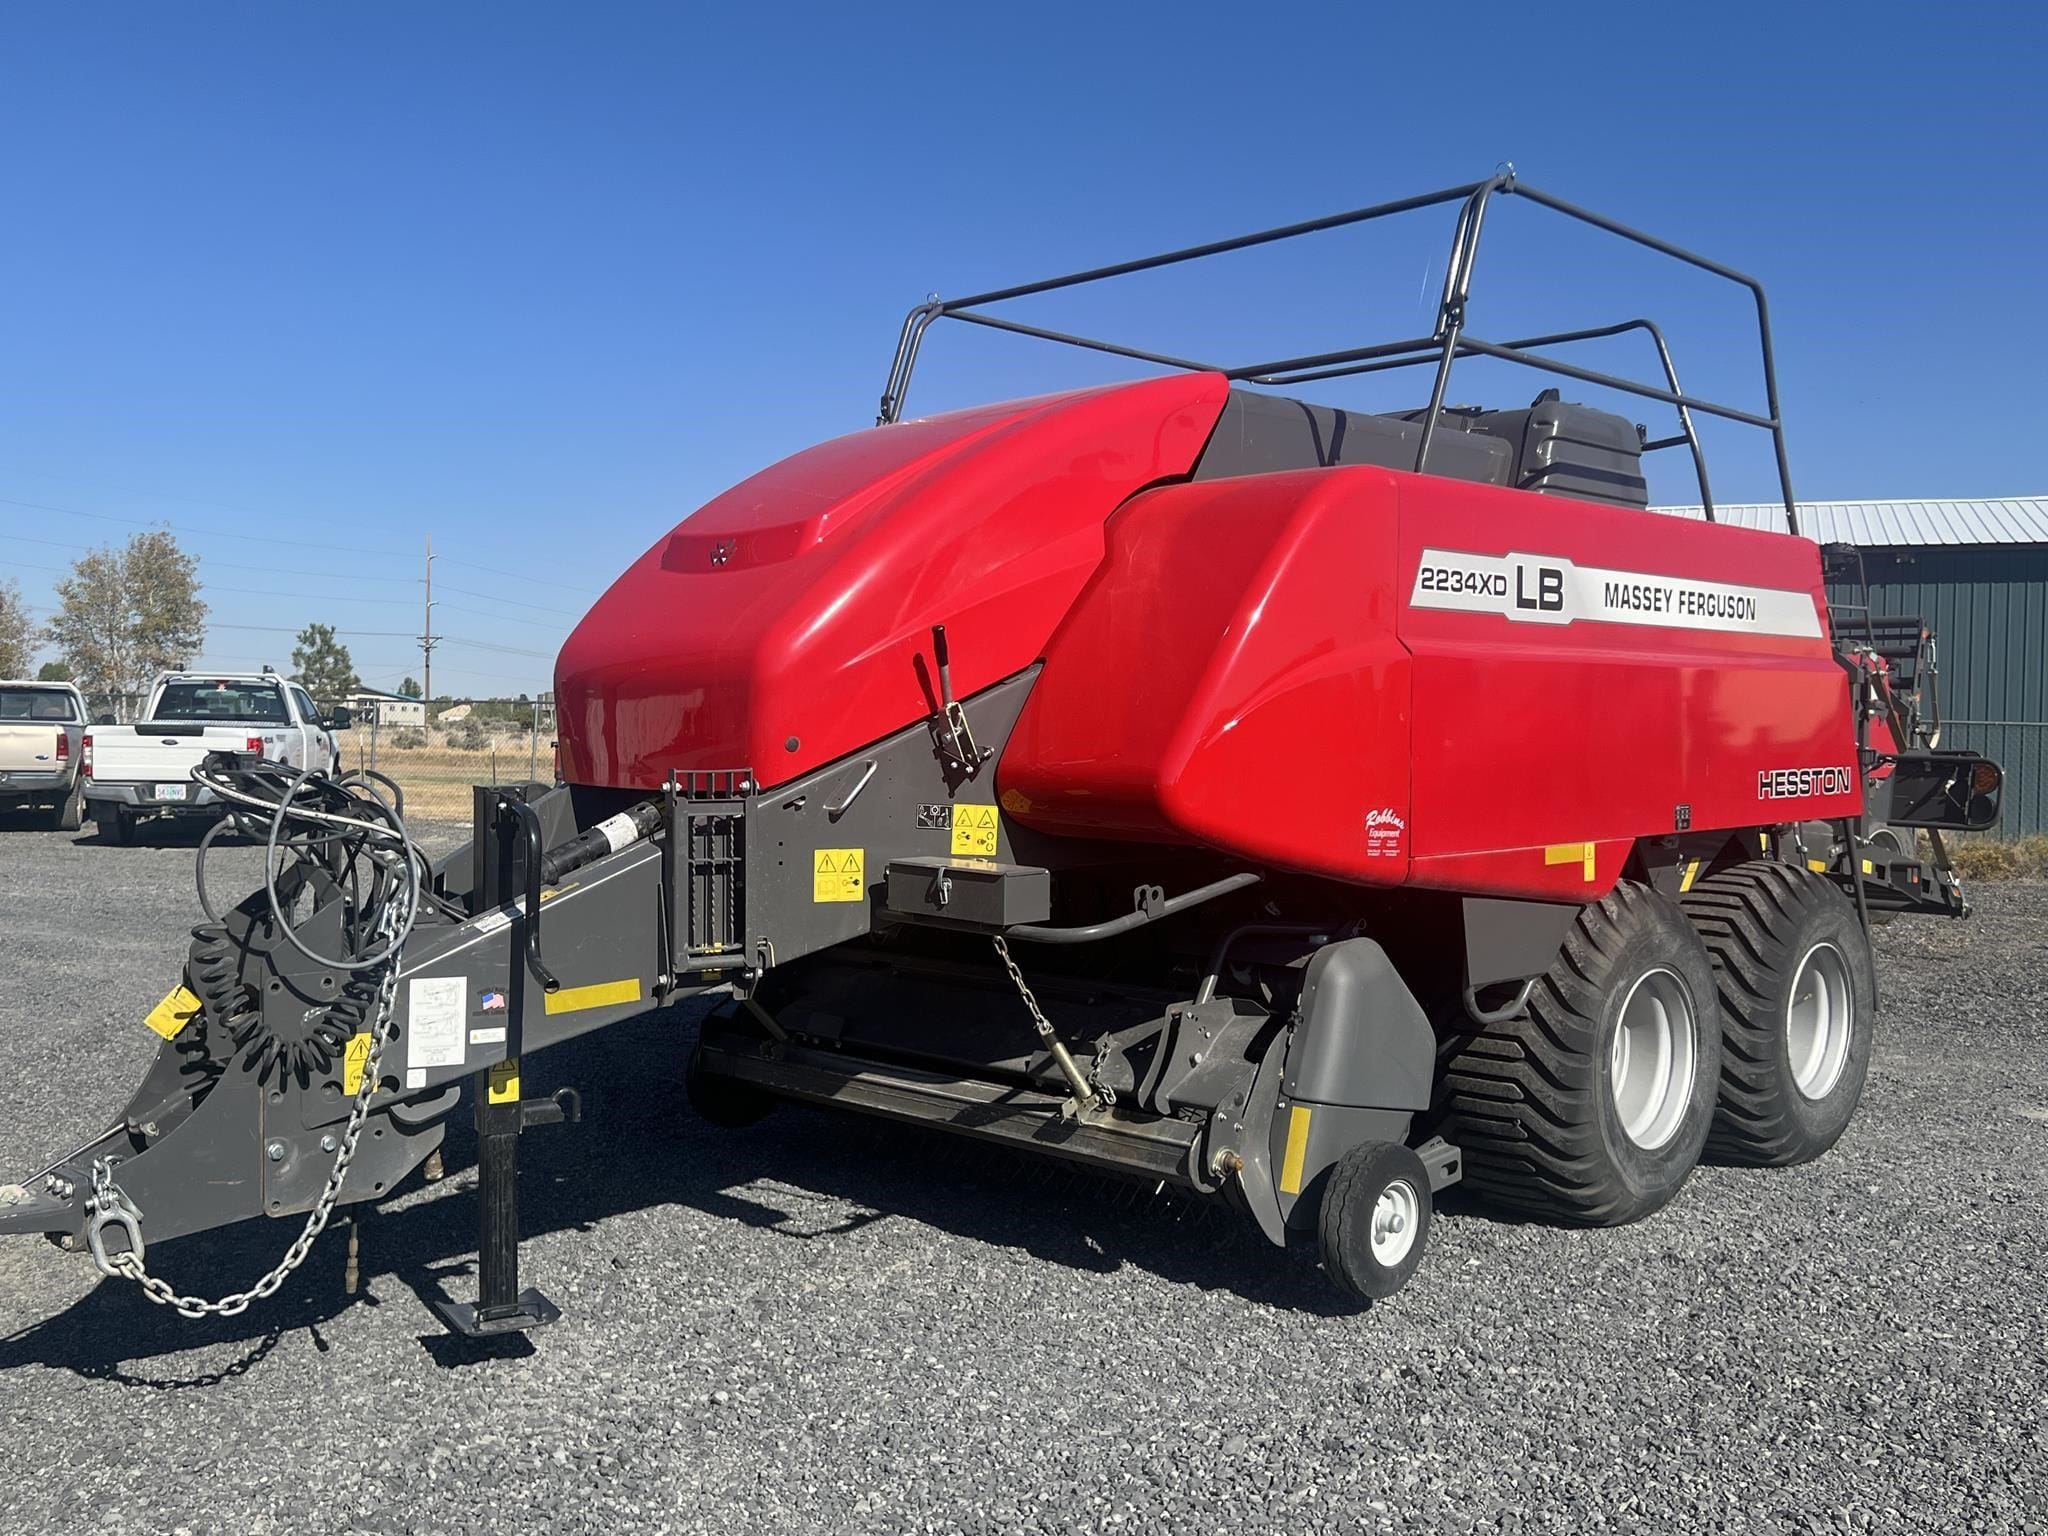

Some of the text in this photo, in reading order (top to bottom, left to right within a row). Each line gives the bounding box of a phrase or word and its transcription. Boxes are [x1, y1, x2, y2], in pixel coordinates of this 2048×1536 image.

[1421, 565, 1563, 611] 2234XD LB
[1604, 582, 1756, 621] MASSEY FERGUSON
[1758, 766, 1851, 800] HESSTON
[1365, 808, 1405, 830] Robbins
